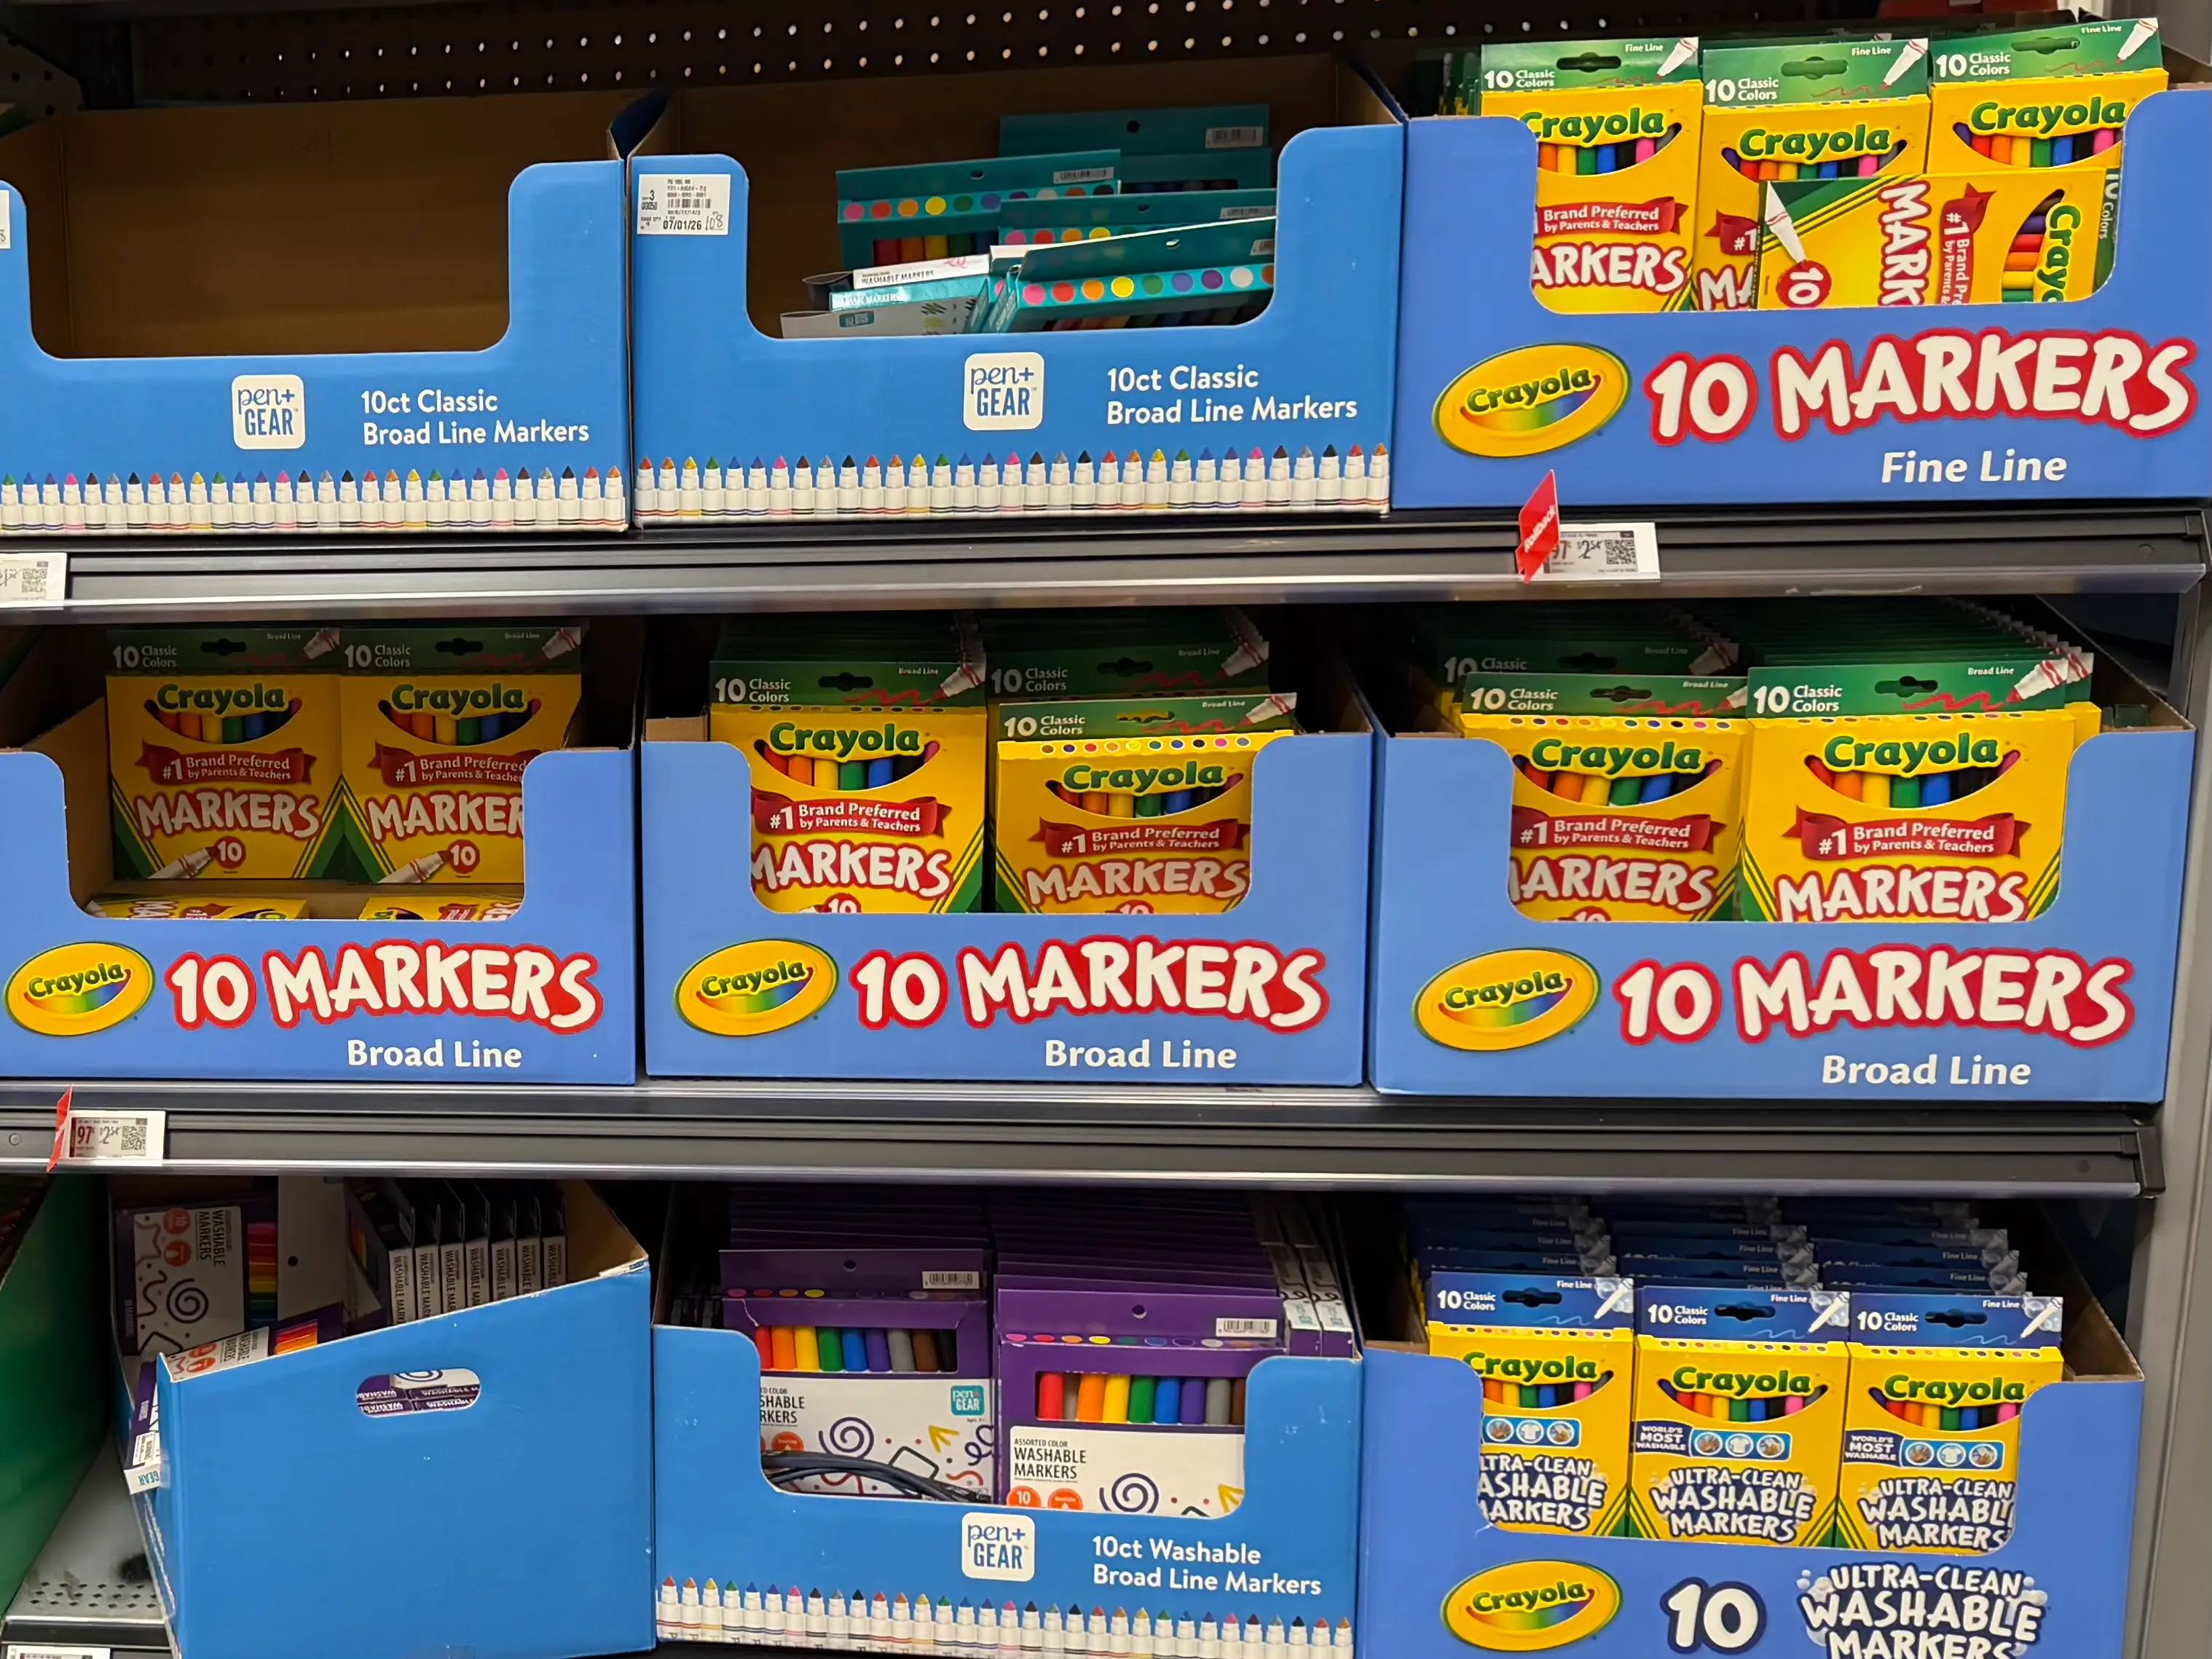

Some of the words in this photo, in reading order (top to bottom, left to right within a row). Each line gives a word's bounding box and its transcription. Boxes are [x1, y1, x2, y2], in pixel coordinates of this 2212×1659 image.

[2080, 25, 2101, 35] Fine
[2101, 24, 2122, 34] Line
[1624, 43, 1643, 52] Fine
[1644, 43, 1664, 52] Line
[1851, 46, 1871, 56] Fine
[1872, 45, 1892, 55] Line
[1969, 52, 2012, 66] Classic
[1516, 69, 1555, 79] Classic
[1935, 53, 1967, 76] 10
[1969, 63, 2011, 76] Colors
[1484, 70, 1514, 90] 10
[1516, 78, 1555, 88] Colors
[1705, 83, 1736, 103] 10
[1738, 76, 1779, 90] Classic
[1738, 89, 1779, 101] Colors
[1524, 107, 1665, 144] Crayola
[1972, 96, 2126, 134] Crayola
[1740, 125, 1891, 159] Crayola
[662, 220, 702, 231] 07/01/26
[1543, 206, 1588, 221] Brand
[1591, 205, 1659, 221] Preferred
[1543, 221, 1558, 233] by
[1559, 220, 1599, 231] Parents
[1602, 218, 1611, 230] &
[1613, 219, 1659, 232] Teachers
[2098, 202, 2114, 240] Colors
[1787, 270, 1824, 303] 10
[970, 366, 1034, 395] pen+
[1107, 367, 1162, 393] 10ct
[1169, 363, 1259, 390] Classic
[1465, 368, 1595, 414] Crayola
[1650, 360, 1748, 438] 10
[1777, 336, 2189, 434] MARKERS
[237, 385, 296, 414] pen+
[361, 390, 412, 414] 10ct
[417, 387, 499, 413] Classic
[976, 387, 1031, 417] GEAR
[1107, 398, 1183, 425] Broad
[1200, 398, 1243, 422] Line
[1251, 396, 1358, 422] Markers
[244, 408, 294, 436] GEAR
[363, 422, 430, 446] Broad
[438, 421, 487, 445] Line
[494, 419, 590, 444] Markers
[1881, 449, 1968, 483] Fine
[1981, 449, 2067, 482] Line
[112, 645, 140, 669] 10
[141, 645, 178, 656] Classic
[142, 657, 177, 668] Colors
[749, 678, 791, 690] Classic
[1967, 667, 1993, 676] Broad
[1993, 666, 2015, 676] Line
[157, 684, 286, 715] Crayola
[391, 683, 524, 715] Crayola
[715, 677, 747, 703] 10
[749, 691, 790, 704] Colors
[1470, 687, 1506, 711] 10
[1509, 688, 1559, 701] Classic
[1752, 685, 1790, 714] 10
[1792, 685, 1843, 698] Classic
[1507, 700, 1555, 711] Colors
[1792, 699, 1840, 712] Colors
[1003, 717, 1038, 738] 10
[1039, 725, 1084, 736] Colors
[1040, 714, 1086, 726] Classic
[769, 722, 920, 758] Crayola
[1825, 733, 1999, 773] Crayola
[162, 760, 184, 781] #1
[186, 754, 226, 768] Brand
[228, 754, 290, 771] Preferred
[1532, 738, 1701, 775] Crayola
[1063, 761, 1223, 793] Crayola
[137, 791, 320, 838] MARKERS
[769, 806, 793, 830] #1
[798, 804, 845, 818] Brand
[848, 803, 921, 821] Preferred
[1520, 821, 1548, 845] #1
[1554, 819, 1606, 832] Brand
[1610, 819, 1691, 838] Preferred
[1818, 829, 1848, 856] #1
[1853, 825, 1908, 840] Brand
[1911, 822, 1995, 840] Preferred
[217, 840, 243, 862] 10
[1854, 840, 1870, 854] by
[1872, 840, 1922, 851] Parents
[1924, 840, 1934, 850] &
[1937, 839, 1994, 854] Teachers
[751, 843, 948, 897] MARKERS
[1026, 861, 1247, 905] MARKERS
[1778, 868, 2025, 923] MARKERS
[28, 964, 126, 999] Crayola
[171, 959, 250, 1022] 10
[268, 945, 596, 1028] MARKERS
[699, 961, 806, 998] Crayola
[857, 956, 940, 1022] 10
[963, 941, 1321, 1027] MARKERS
[1444, 969, 1565, 1011] Crayola
[1620, 966, 1712, 1037] 10
[1739, 950, 2126, 1041] MARKERS
[346, 1039, 444, 1068] Broad
[453, 1040, 523, 1069] Line
[1045, 1039, 1151, 1068] Broad
[1161, 1039, 1237, 1068] Line
[1822, 1054, 1938, 1086] Broad
[1949, 1054, 2031, 1085] Line
[198, 1210, 212, 1261] MARKERS
[211, 1209, 226, 1266] WASHABLE
[393, 1256, 405, 1299] WASHABLE
[445, 1250, 456, 1295] WASHABLE
[1556, 1280, 1574, 1289] Fine
[1575, 1280, 1593, 1289] Line
[1436, 1290, 1462, 1309] 10
[1463, 1291, 1497, 1302] Classic
[1463, 1301, 1495, 1311] Colors
[1857, 1311, 1883, 1331] 10
[1884, 1312, 1919, 1323] Classic
[1884, 1322, 1918, 1332] Colors
[1463, 1352, 1597, 1383] Crayola
[1673, 1366, 1811, 1397] Crayola
[1884, 1374, 2025, 1406] Crayola
[955, 1398, 980, 1411] GEAR
[1014, 1438, 1047, 1447] ASSORTED
[1047, 1439, 1068, 1448] COLOR
[1640, 1433, 1685, 1444] MOST
[1641, 1425, 1683, 1434] WORLD'S
[1013, 1446, 1087, 1464] WASHABLE
[1636, 1441, 1687, 1451] WASHABLE
[1013, 1462, 1077, 1480] MARKERS
[1671, 1467, 1802, 1490] ULTRA-CLEAN
[1016, 1490, 1031, 1505] 10
[1880, 1478, 2014, 1499] ULTRA-CLEAN
[1650, 1485, 1814, 1520] WASHABLE
[967, 1521, 1026, 1548] pen+
[1670, 1511, 1796, 1542] MARKERS
[1880, 1524, 2005, 1550] MARKERS
[973, 1543, 1024, 1569] GEAR
[1093, 1536, 1143, 1559] 10ct
[1149, 1537, 1262, 1565] Washable
[1093, 1564, 1162, 1588] Broad
[1169, 1568, 1218, 1591] Line
[1225, 1571, 1322, 1596] Markers
[1830, 1564, 2023, 1596] ULTRA-CLEAN
[1472, 1580, 1587, 1613] Crayola
[1668, 1583, 1758, 1648] 10
[1800, 1590, 2042, 1642] WASHABLE
